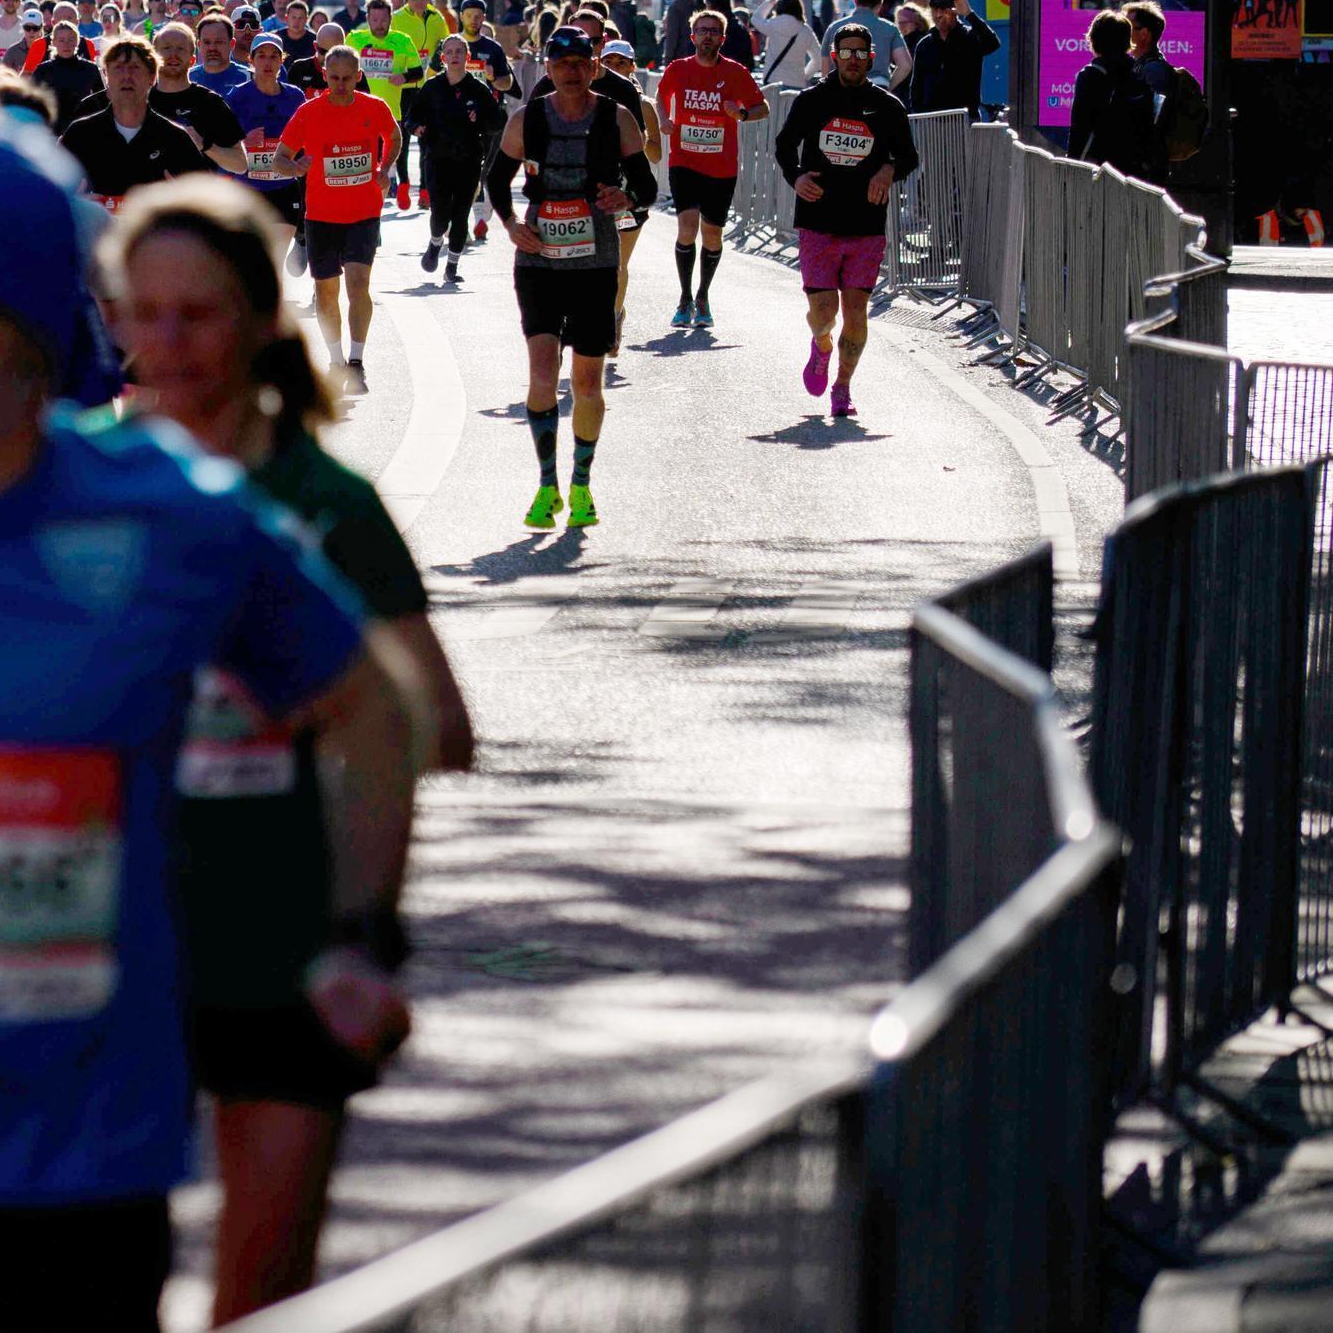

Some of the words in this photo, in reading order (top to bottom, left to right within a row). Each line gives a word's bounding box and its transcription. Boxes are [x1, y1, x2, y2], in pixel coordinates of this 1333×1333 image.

[684, 89, 722, 102] TEAM
[684, 100, 721, 112] HASPA
[841, 122, 865, 133] Haspa
[341, 144, 362, 154] Haspa
[553, 205, 579, 217] Haspa
